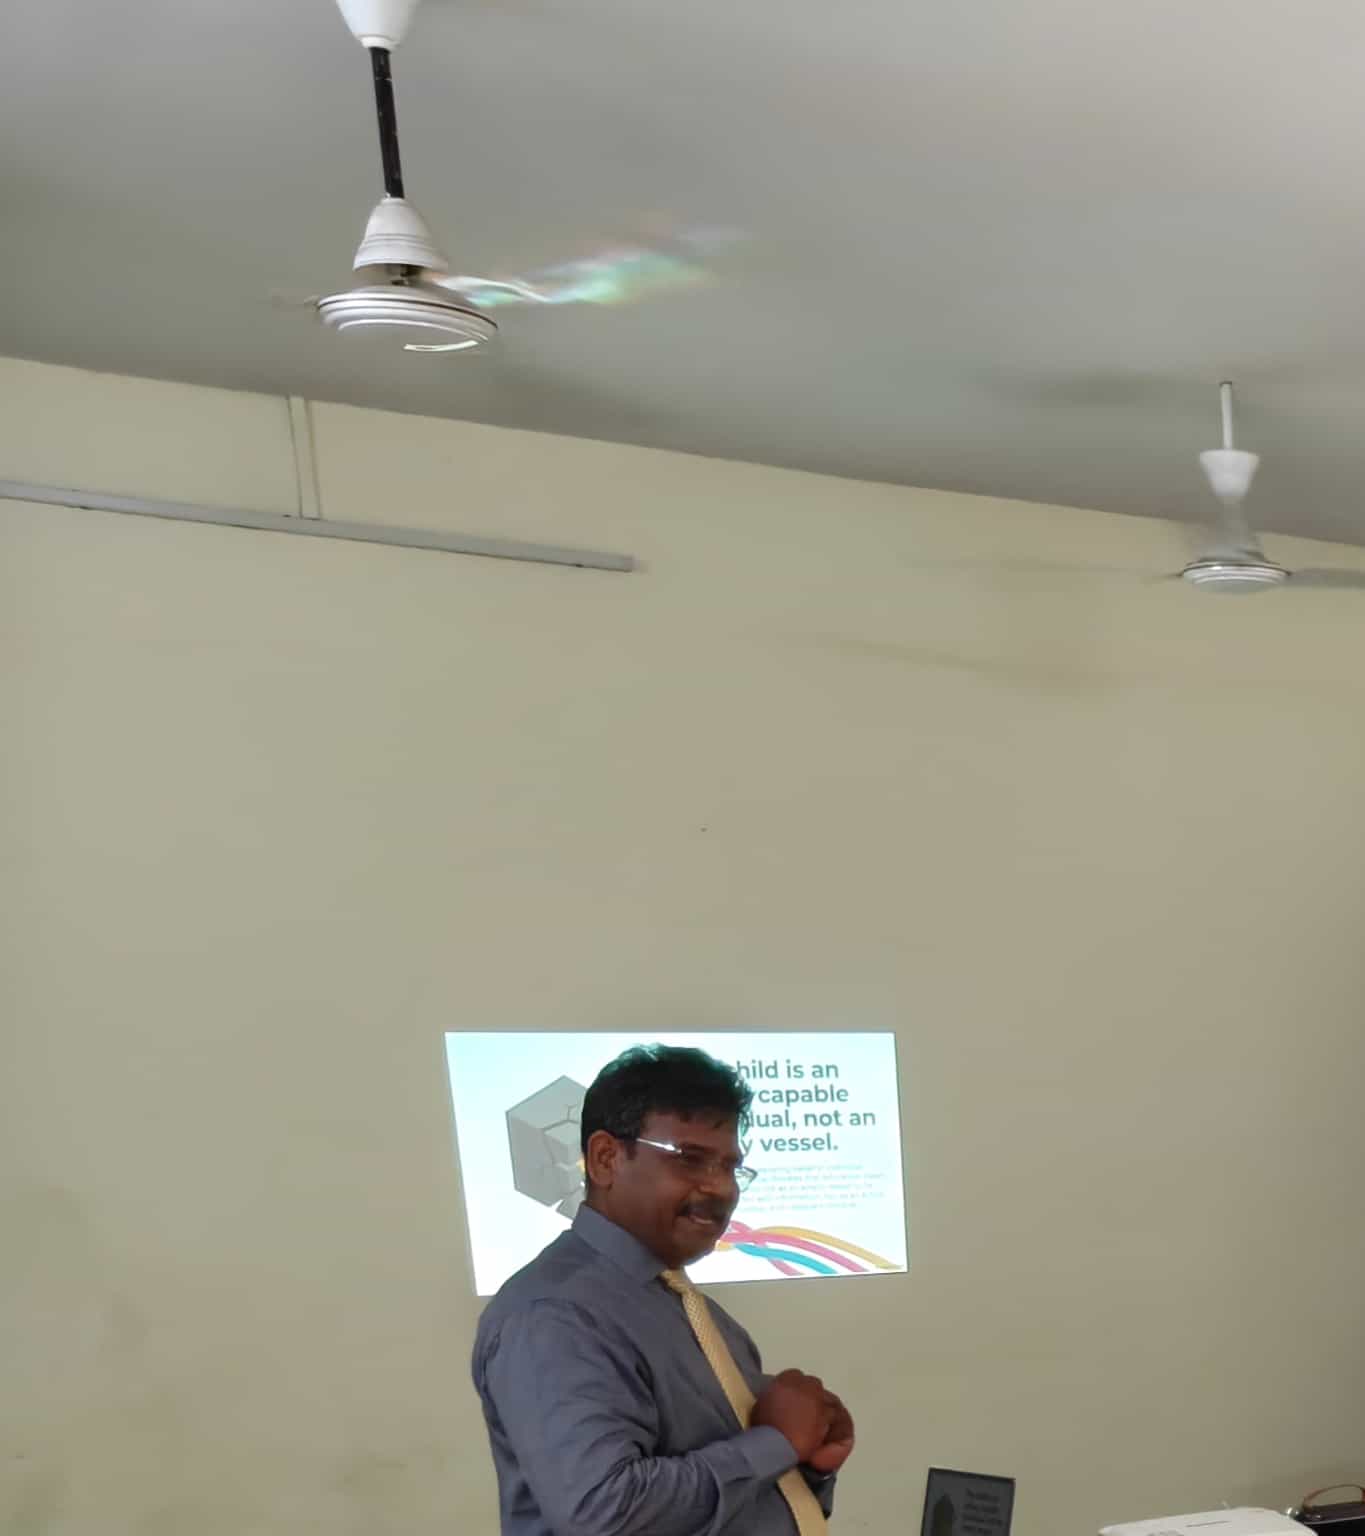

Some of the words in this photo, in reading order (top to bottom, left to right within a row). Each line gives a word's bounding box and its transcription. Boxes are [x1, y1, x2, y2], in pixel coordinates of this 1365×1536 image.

[736, 1059, 779, 1079] hild
[786, 1059, 804, 1079] is
[811, 1064, 839, 1079] an
[758, 1084, 849, 1108] capable
[804, 1110, 842, 1127] not
[849, 1112, 876, 1126] an
[760, 1132, 839, 1152] vessel.
